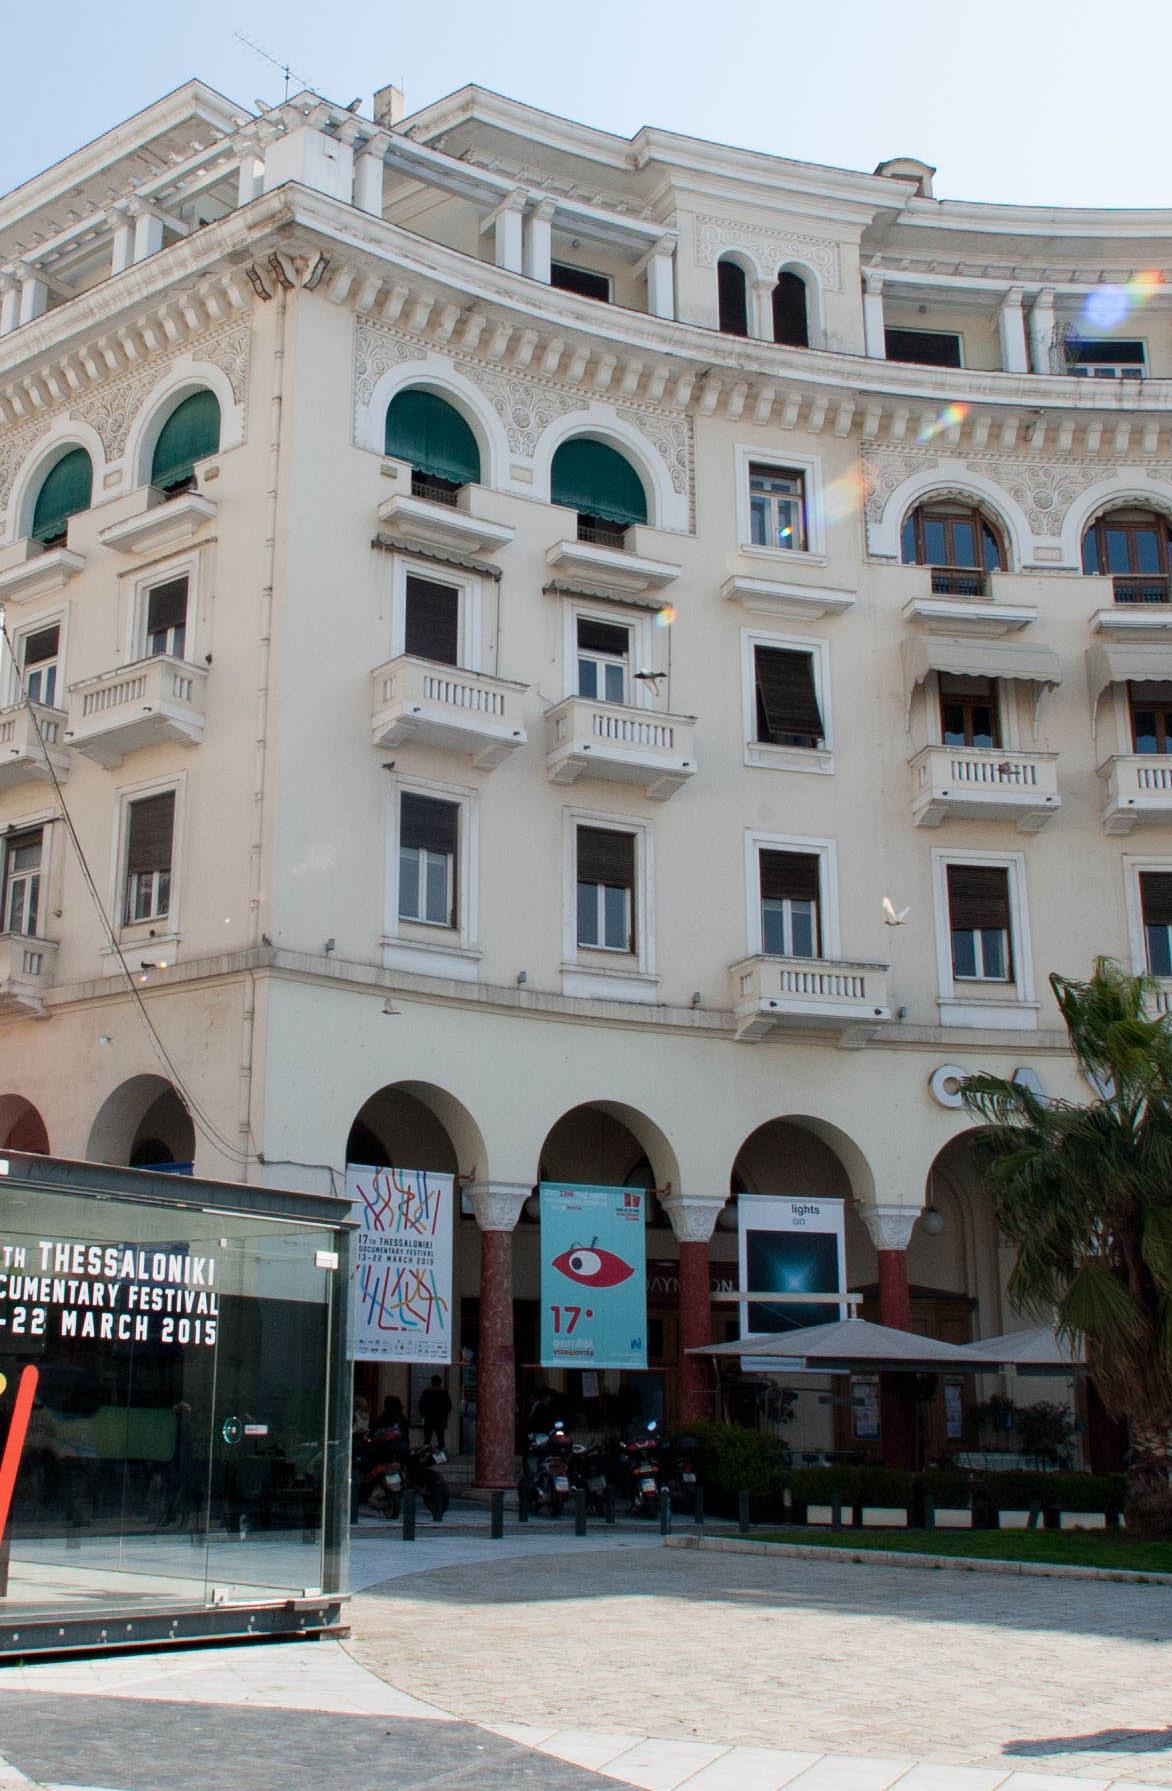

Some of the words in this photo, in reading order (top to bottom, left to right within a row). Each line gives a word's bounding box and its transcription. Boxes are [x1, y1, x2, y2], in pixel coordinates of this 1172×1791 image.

[791, 1203, 820, 1216] lights
[792, 1218, 806, 1226] on
[379, 1236, 433, 1249] THESSALONIKI
[358, 1245, 403, 1255] DOCUMENTARY
[406, 1248, 435, 1257] FESTIVAL
[39, 1241, 215, 1286] THESSALONIKI
[386, 1255, 413, 1264] MARCH
[416, 1257, 434, 1266] 2015
[128, 1285, 220, 1316] FESTIVAL
[61, 1309, 149, 1341] MARCH
[161, 1317, 217, 1346] 2015
